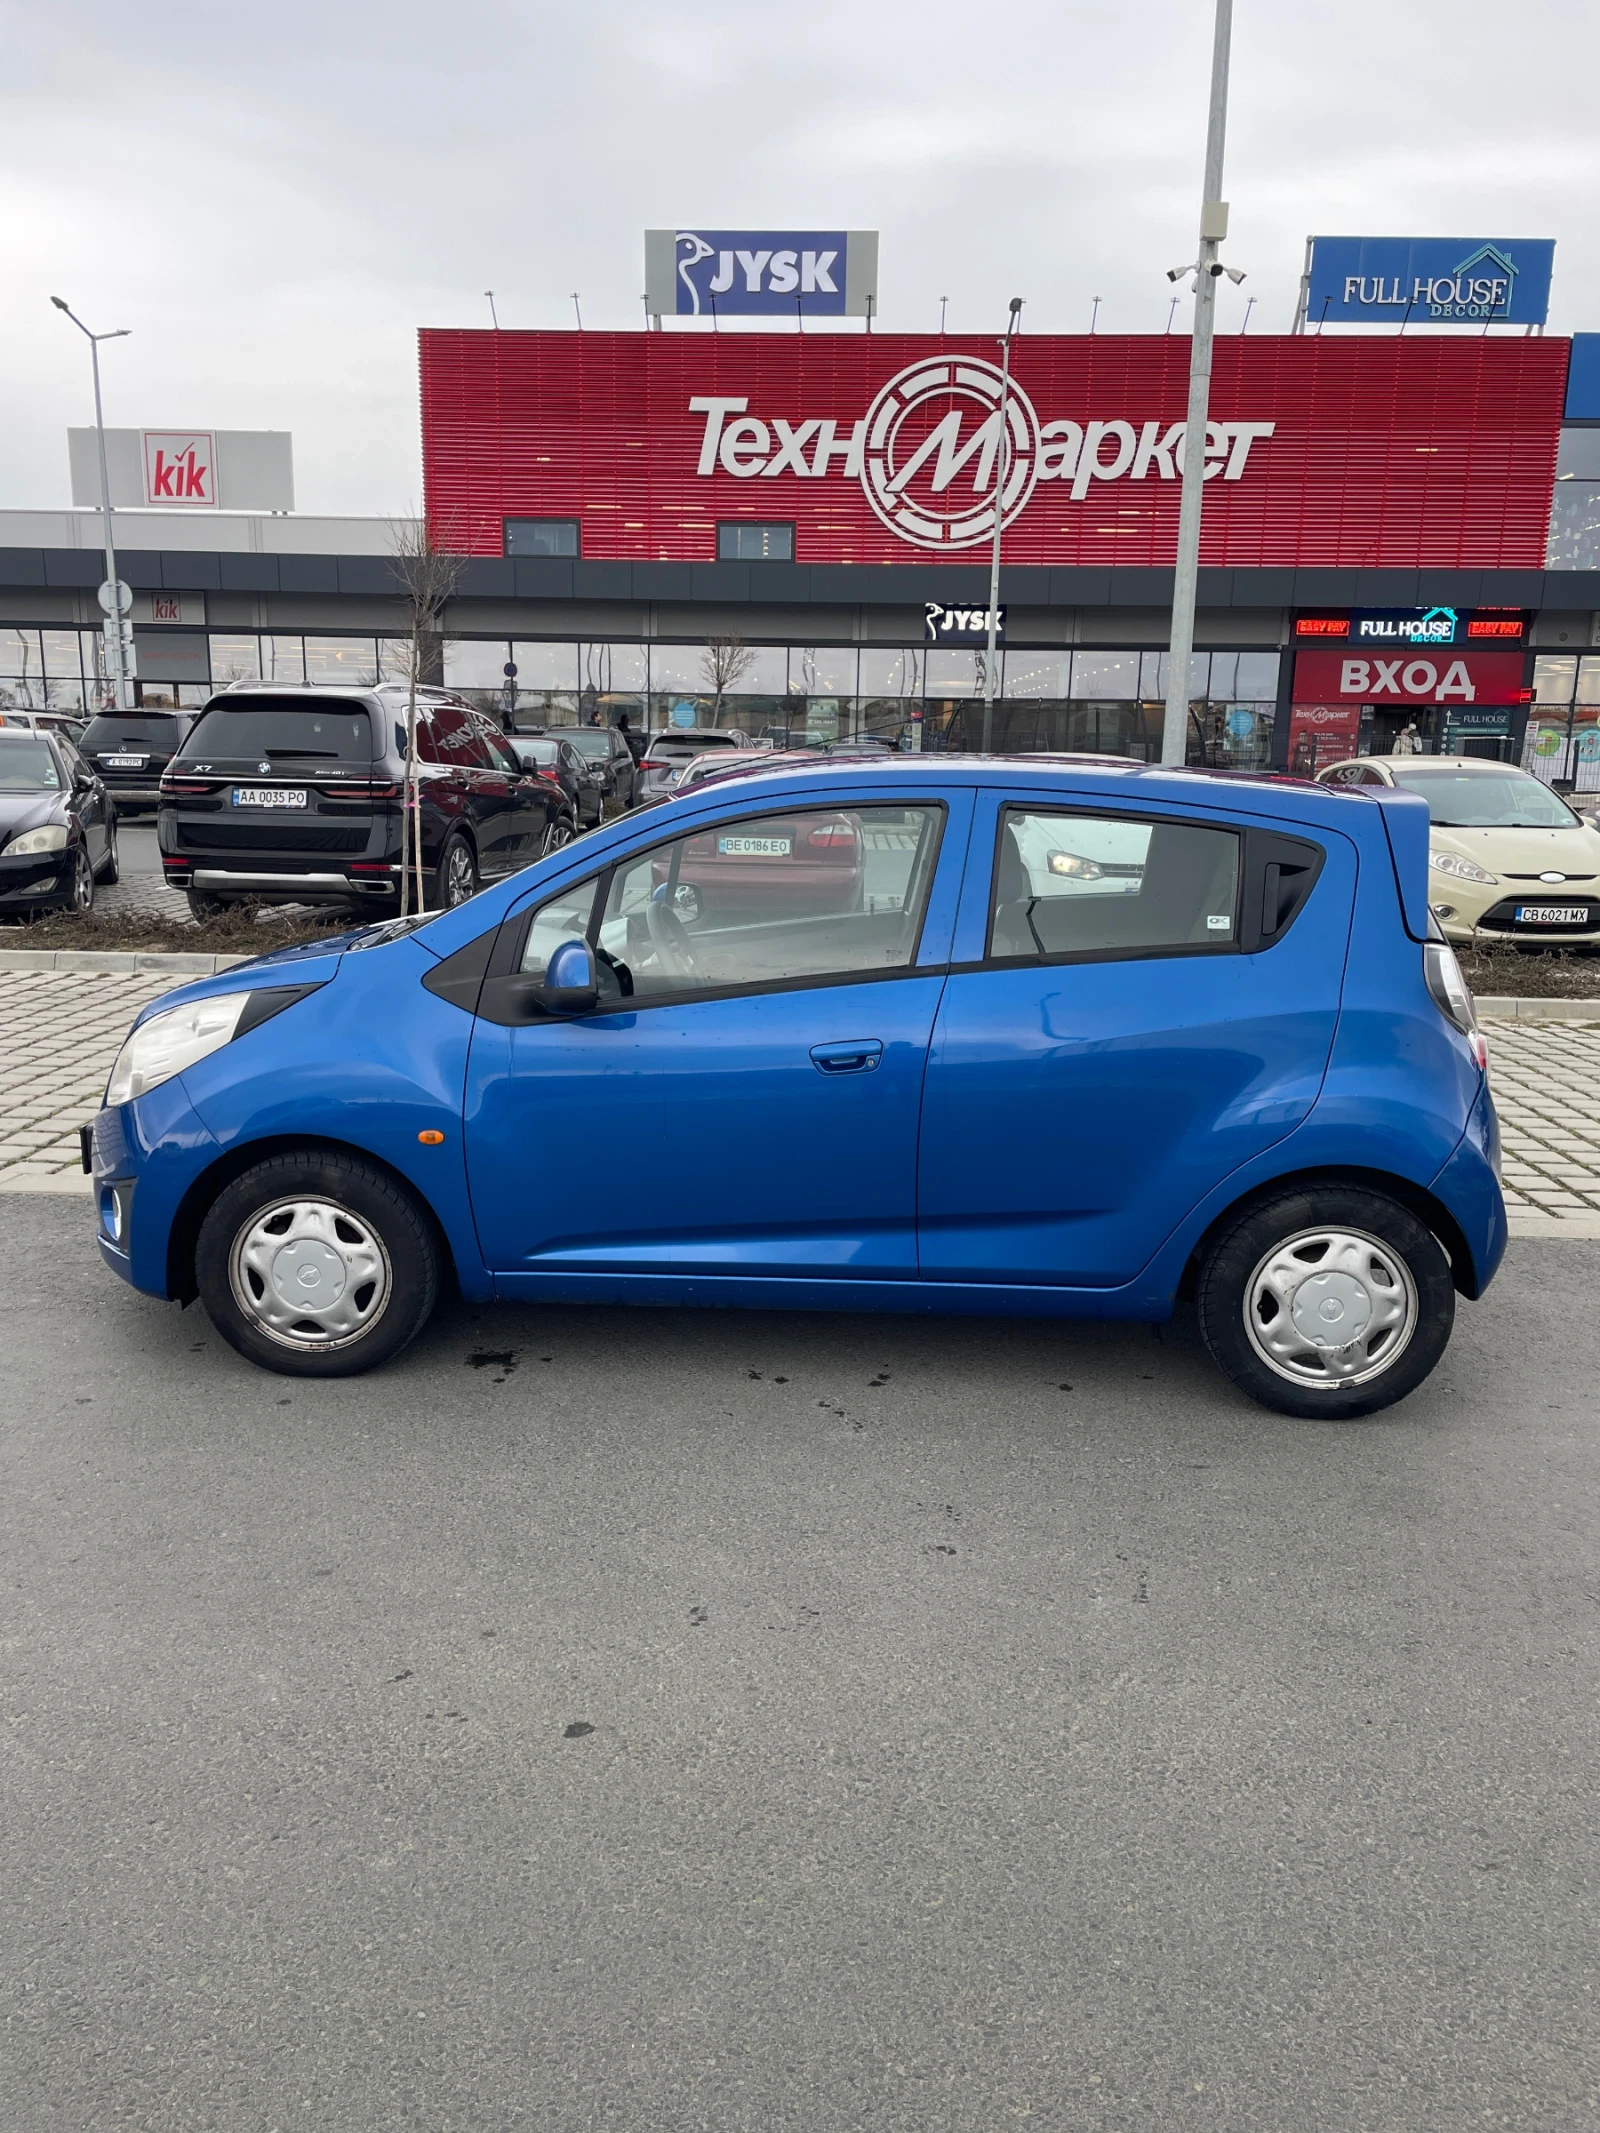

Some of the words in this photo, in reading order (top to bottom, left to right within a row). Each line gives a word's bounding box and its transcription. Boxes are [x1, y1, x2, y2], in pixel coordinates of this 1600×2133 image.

[709, 250, 839, 293] JYSK
[1343, 276, 1407, 304] FULL
[1412, 277, 1508, 305] HOUSE
[1429, 304, 1491, 317] DECOR
[940, 610, 1003, 631] JYSK
[1360, 620, 1398, 637] FULL
[1398, 621, 1453, 637] HOUSE
[1410, 635, 1443, 643] DECOR
[1340, 659, 1476, 702] ВХОД
[1463, 714, 1481, 724] FULL
[1481, 714, 1508, 724] HOUSE
[193, 765, 213, 773] X7
[240, 790, 256, 803] AA
[259, 791, 285, 804] 0035
[288, 792, 305, 804] PO
[726, 839, 742, 851] BE
[744, 840, 769, 852] 0186
[770, 841, 787, 852] EO
[1523, 909, 1539, 921] CB
[1541, 909, 1568, 921] 6021
[1570, 909, 1587, 922] MX
